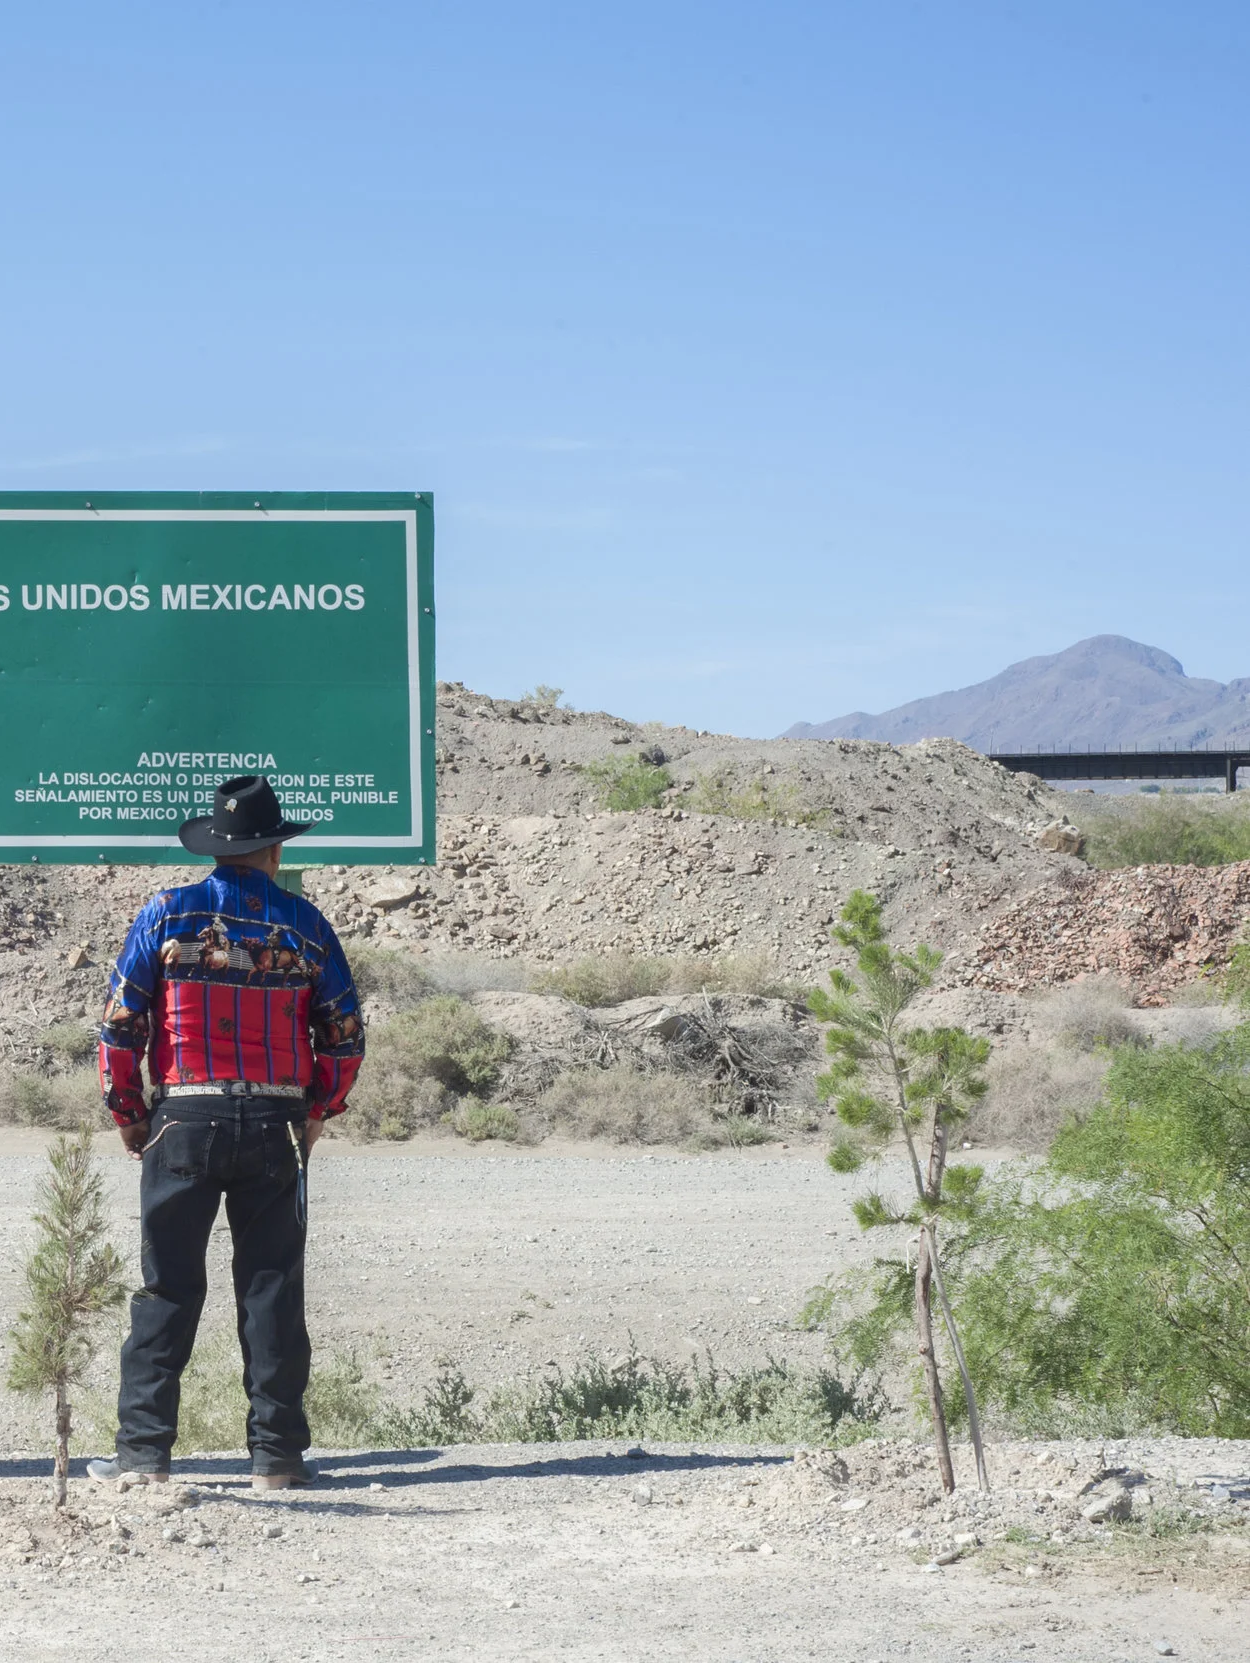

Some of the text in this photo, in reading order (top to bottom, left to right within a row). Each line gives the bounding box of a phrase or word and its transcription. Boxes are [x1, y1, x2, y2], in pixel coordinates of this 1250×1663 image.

[21, 583, 151, 611] UNIDOS
[161, 583, 366, 611] MEXICANOS
[137, 751, 278, 769] ADVERTENCIA
[38, 771, 60, 785] LA
[63, 772, 172, 786] DISLOCACION
[175, 773, 188, 786] O
[309, 774, 330, 787] DE
[334, 774, 375, 787] ESTE
[14, 786, 138, 803] SEÑALAMIENTO
[142, 790, 163, 803] ES
[167, 790, 189, 804] UN
[274, 791, 327, 804] DERAL
[330, 791, 399, 805] PUNIBLE
[78, 806, 113, 820] POR
[116, 807, 178, 820] MEXICO
[181, 807, 193, 821] Y
